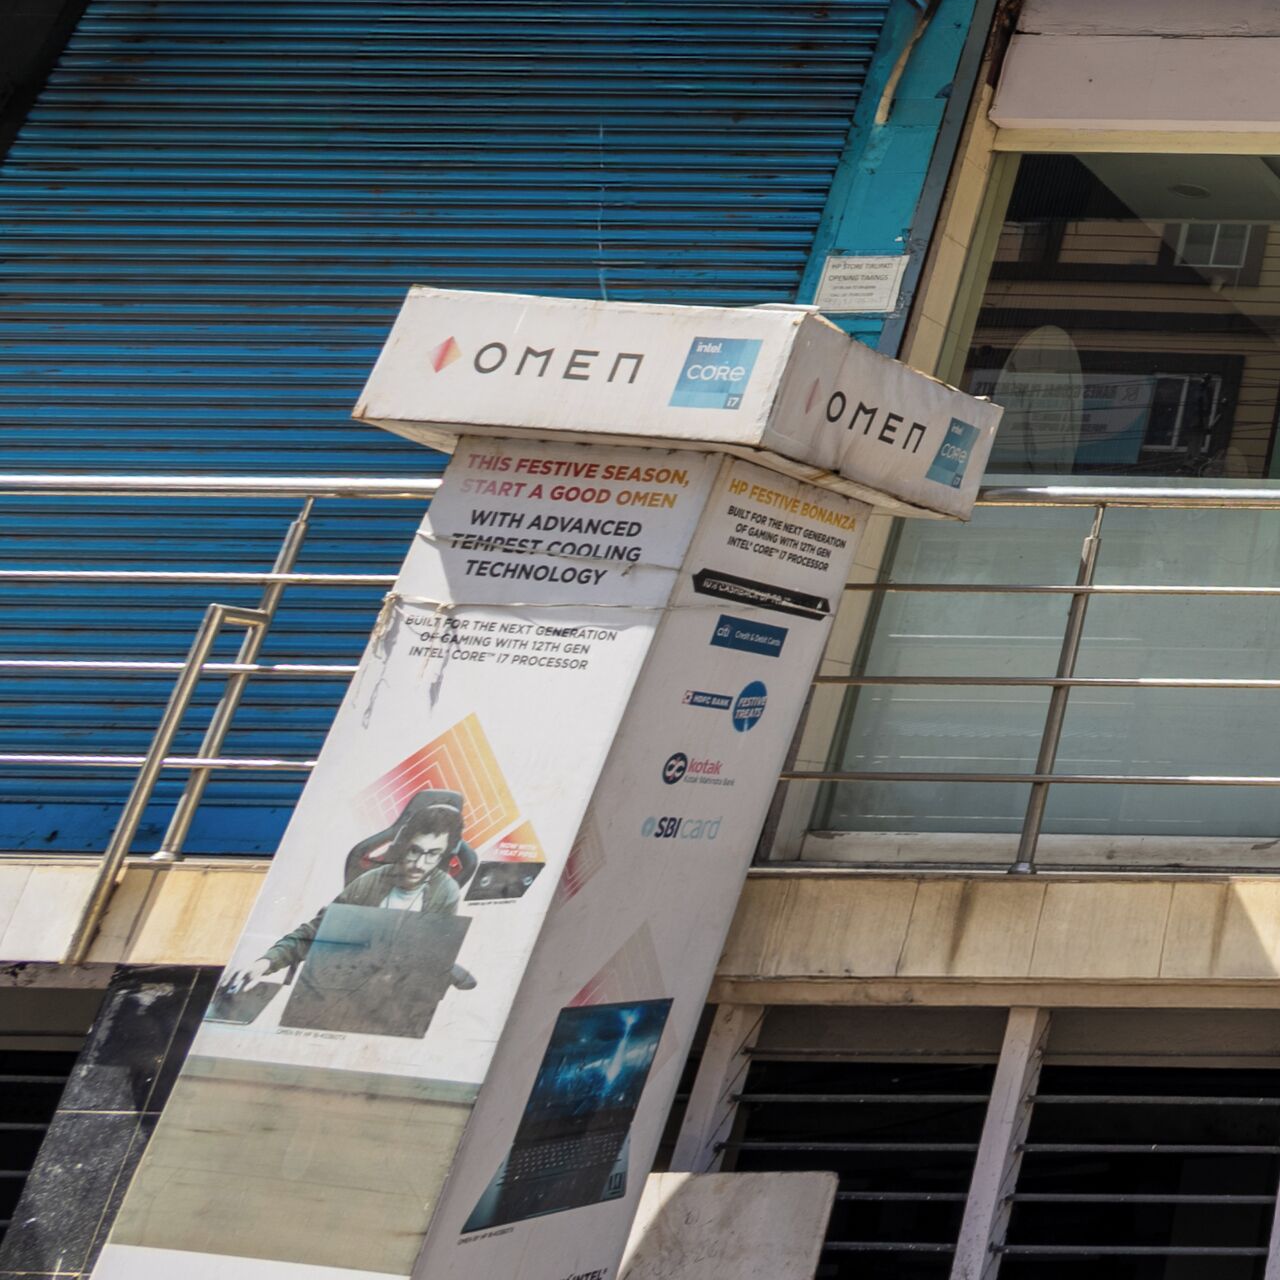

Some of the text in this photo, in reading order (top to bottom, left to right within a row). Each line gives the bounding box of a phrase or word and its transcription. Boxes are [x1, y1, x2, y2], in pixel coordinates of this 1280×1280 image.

[726, 396, 740, 408] i7
[467, 453, 690, 488] THIS FESTIVE SEASON,
[460, 478, 678, 509] START A GOOD OMEN
[728, 478, 857, 532] HP FESTIVE BONANZA
[470, 509, 642, 537] WITH ADVANCED
[727, 505, 847, 549] BUILT FOR THE NEXT GENERATION
[450, 533, 642, 563] TEMPEST COOLING
[735, 523, 832, 559] OF GAMING WITH 12TH GEN
[465, 559, 609, 586] TECHNOLOGY
[787, 552, 829, 572] PROCESSOR
[405, 616, 618, 642] BUILT FOR THE NEXT GENERATION
[420, 631, 591, 656] OF GAMING WITH 12TH GEN
[511, 655, 589, 670] PROCESSOR
[693, 694, 731, 707] HDFC BANK
[735, 707, 763, 719] TREATS
[737, 695, 768, 708] FESTIVE
[687, 758, 723, 775] kotak
